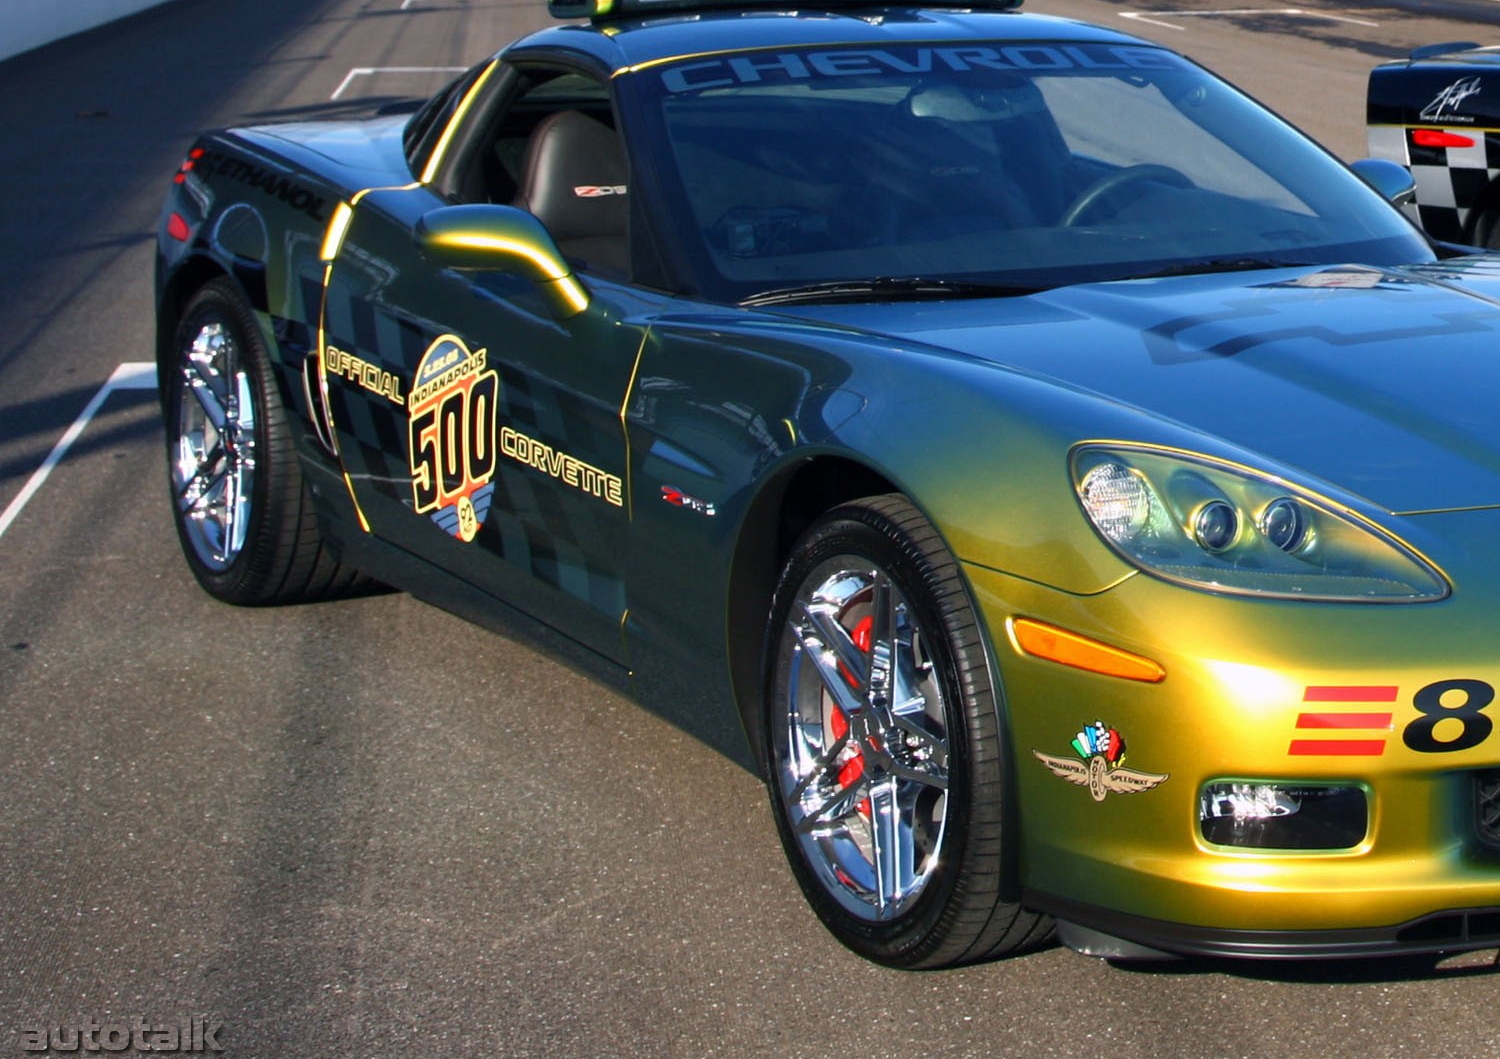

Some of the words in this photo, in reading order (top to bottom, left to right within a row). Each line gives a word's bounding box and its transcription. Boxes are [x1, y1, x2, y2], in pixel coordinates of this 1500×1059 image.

[660, 44, 1178, 93] CHEVROLE
[326, 345, 404, 406] OFFICIAL
[410, 352, 486, 407] INDIANAPOLIS
[410, 373, 496, 511] 500
[500, 426, 623, 506] CORVETTE
[1048, 760, 1087, 775] INDIANAPOLIS
[1110, 774, 1149, 786] SPEEDWAY
